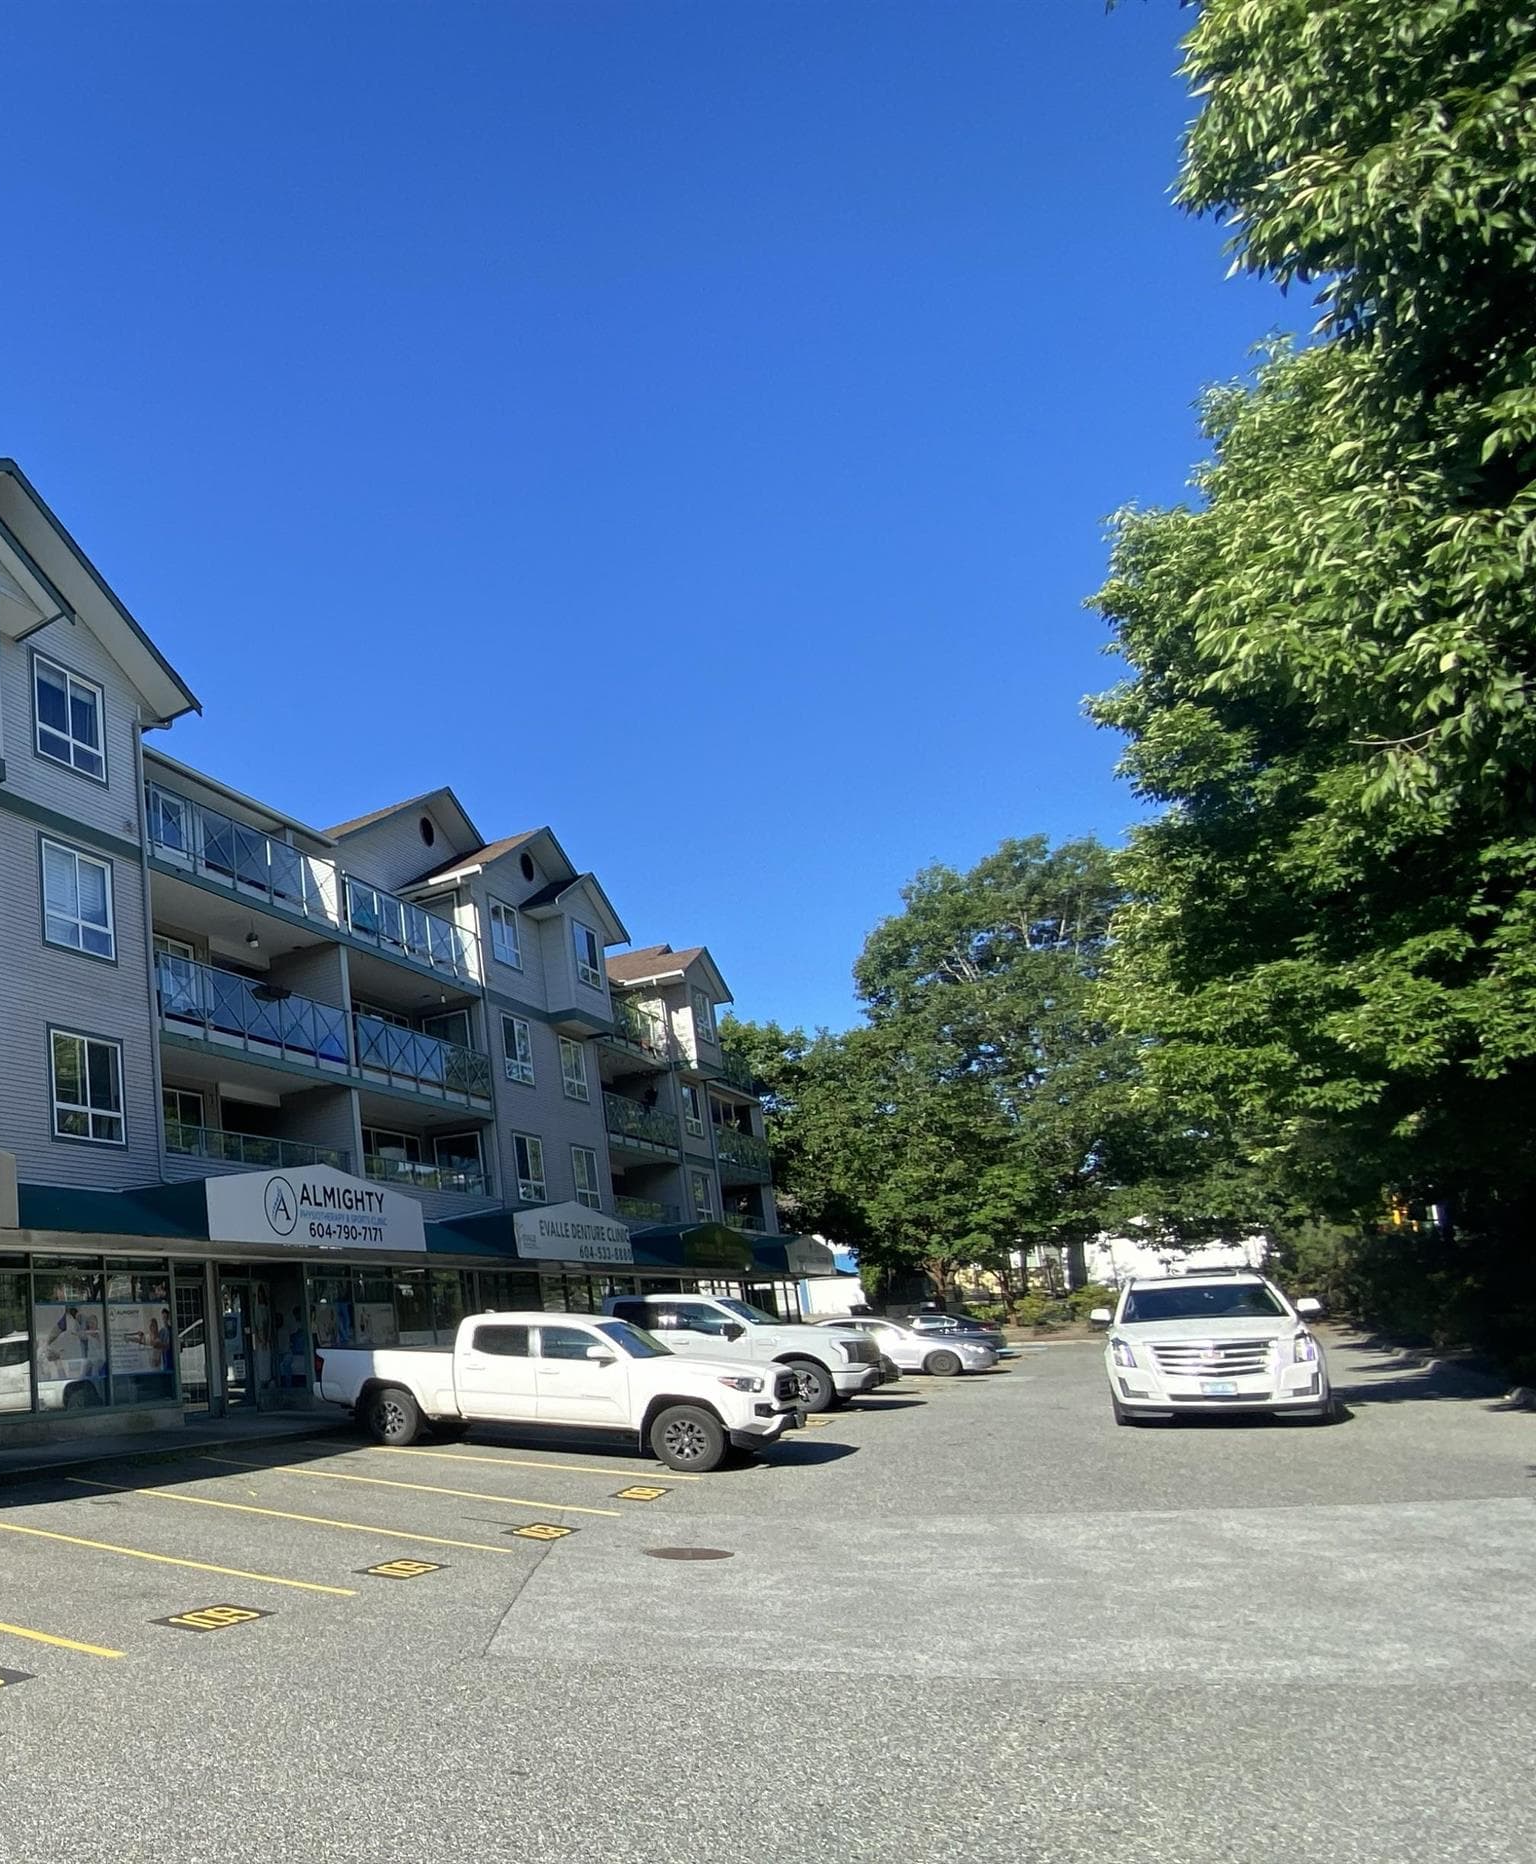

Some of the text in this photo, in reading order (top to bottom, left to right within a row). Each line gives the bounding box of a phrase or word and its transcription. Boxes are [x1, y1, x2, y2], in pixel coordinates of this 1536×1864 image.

[300, 1183, 384, 1213] ALMIGHTY
[309, 1222, 383, 1242] 604-790-7171
[571, 1223, 605, 1241] DENTURE
[606, 1227, 630, 1243] CLINIC
[368, 1560, 440, 1578] 109
[169, 1606, 262, 1630] 109
